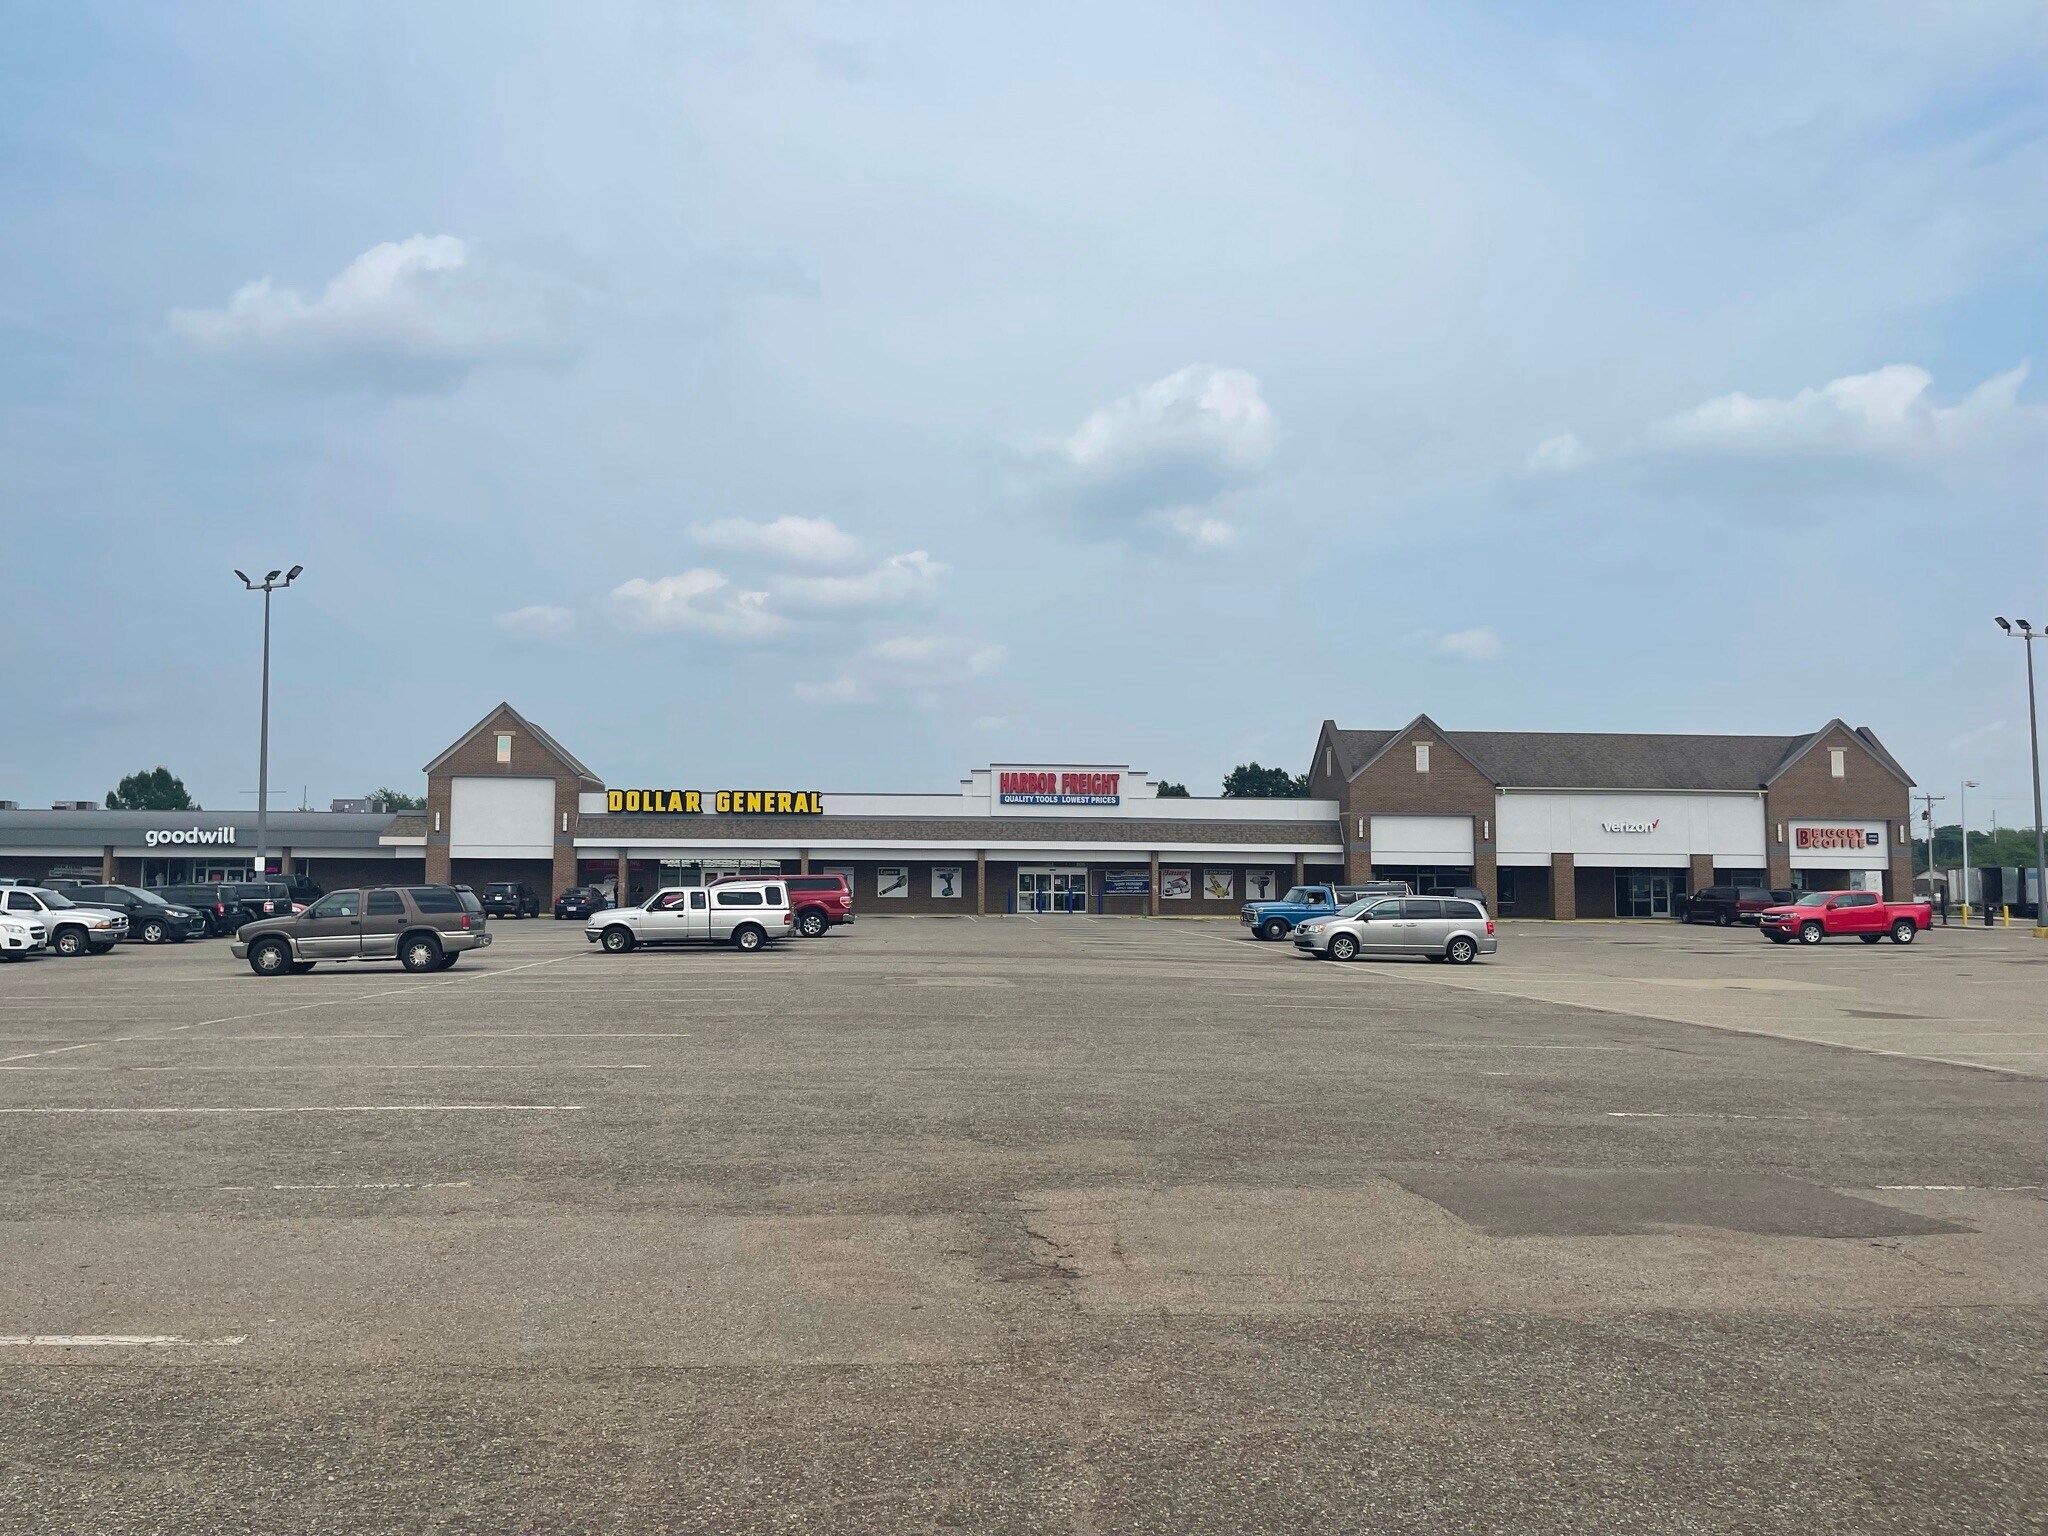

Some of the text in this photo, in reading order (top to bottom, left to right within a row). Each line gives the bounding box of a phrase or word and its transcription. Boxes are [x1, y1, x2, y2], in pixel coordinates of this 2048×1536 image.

[1000, 772, 1120, 795] HARBOR FREIGHT
[608, 790, 823, 814] DOLLAR GENERAL
[1004, 795, 1116, 804] QUALITY TOOLS LOWEST PRICES
[145, 826, 236, 847] goodwill
[1601, 821, 1654, 833] verizon
